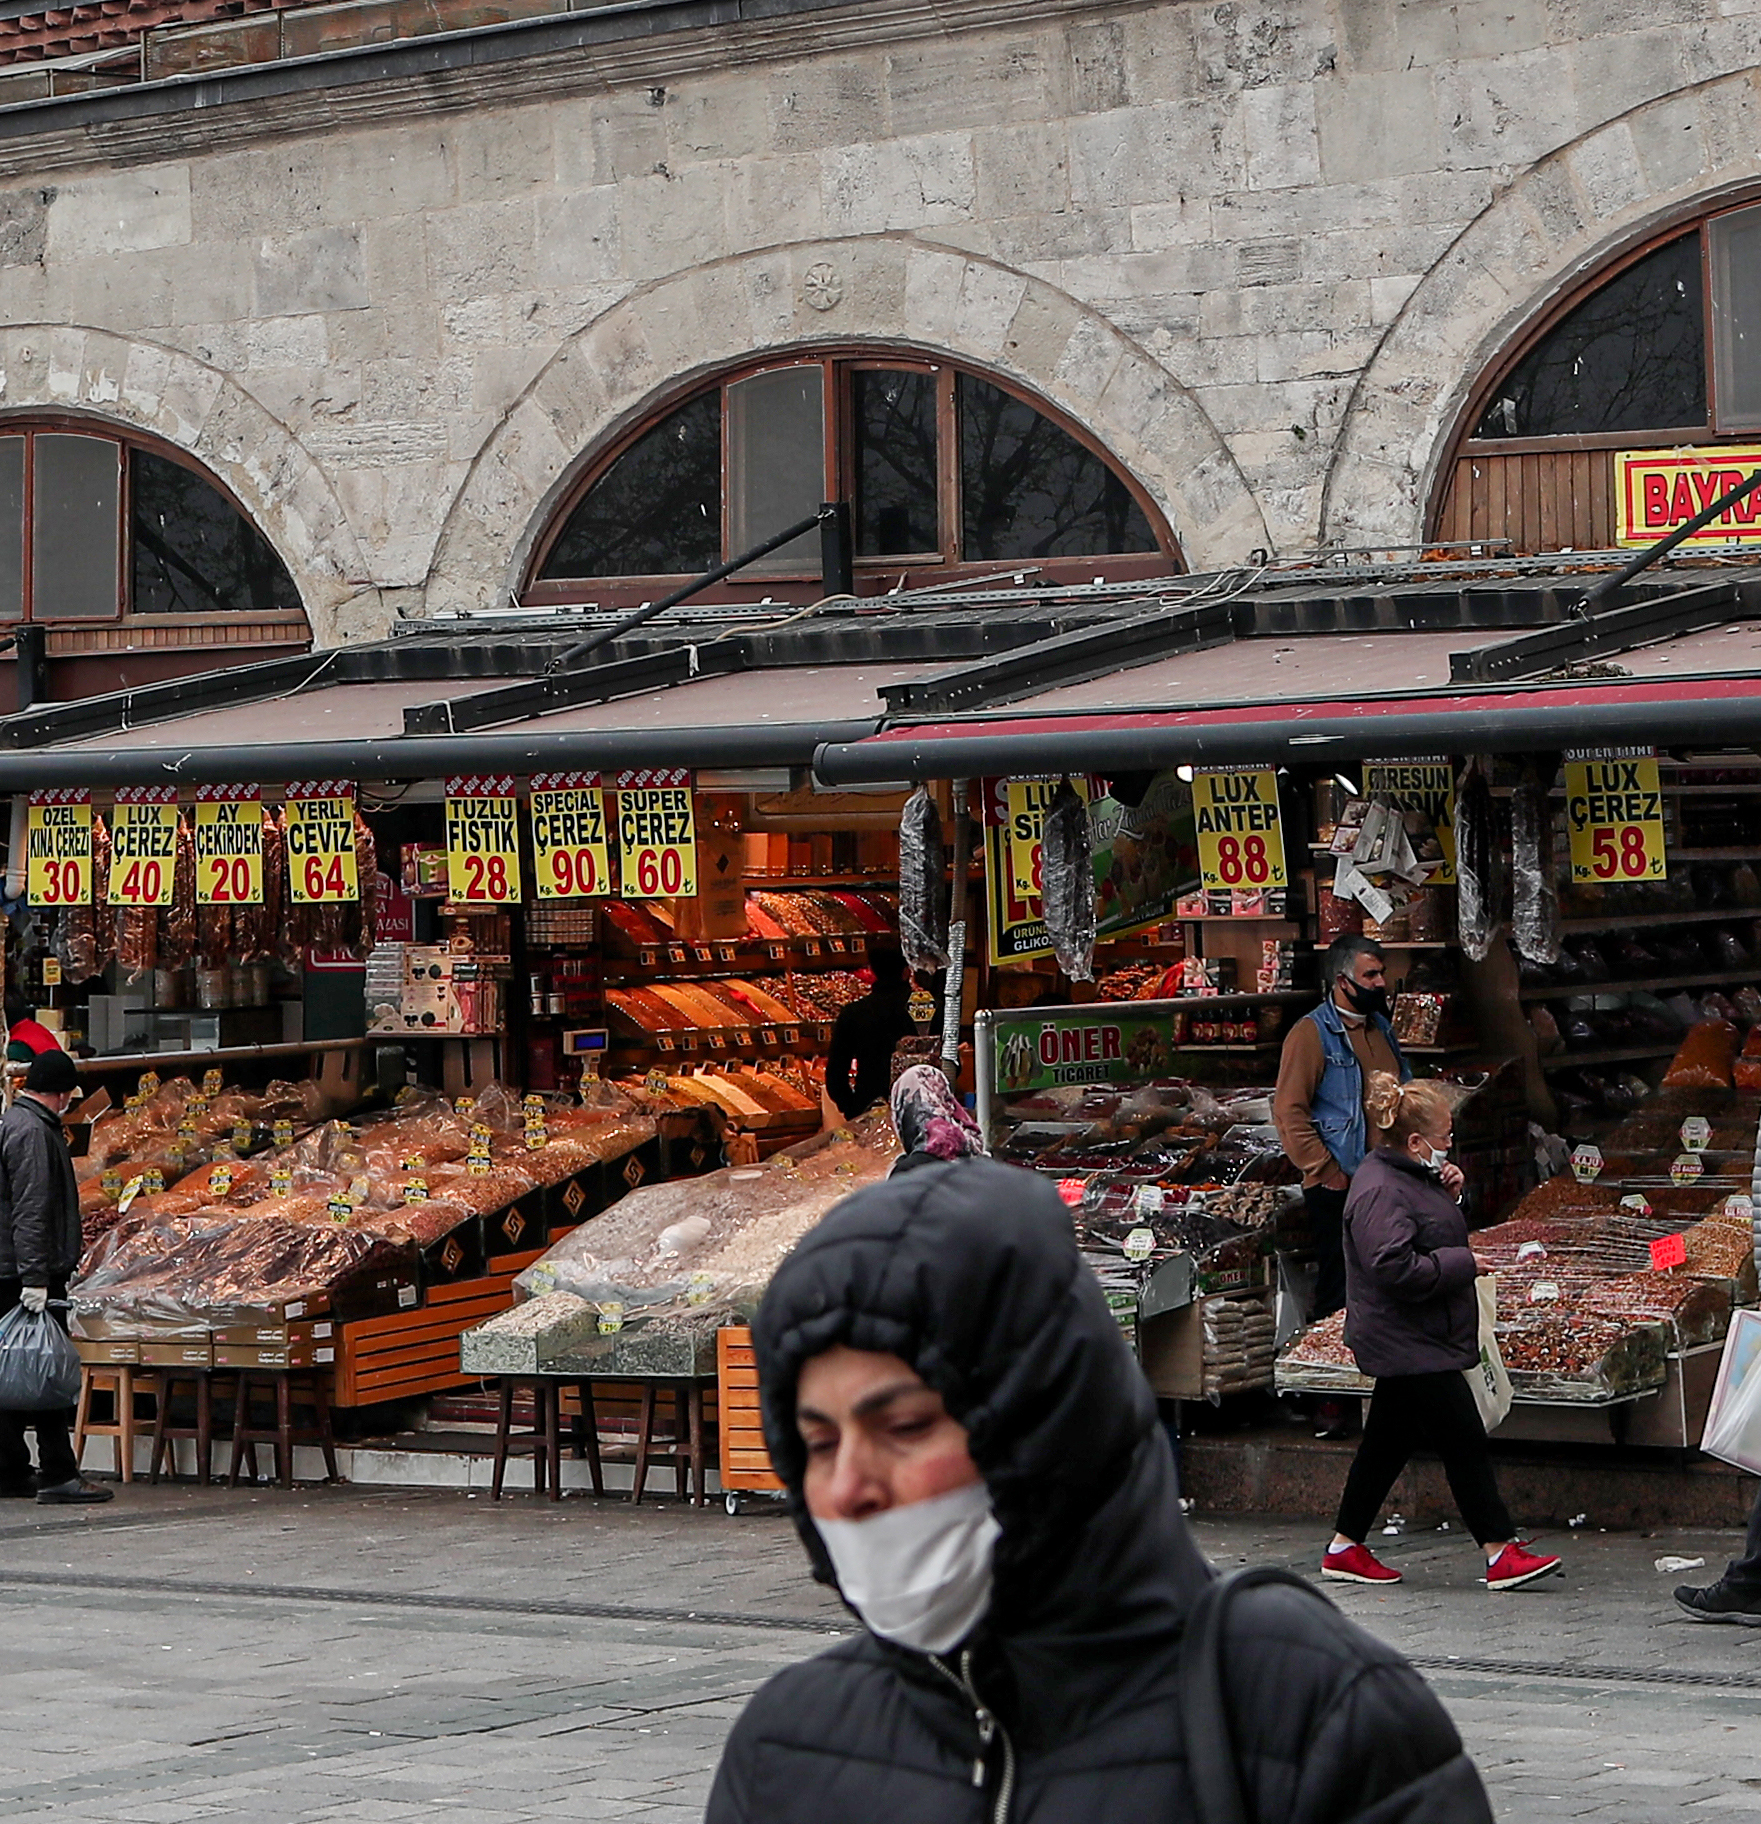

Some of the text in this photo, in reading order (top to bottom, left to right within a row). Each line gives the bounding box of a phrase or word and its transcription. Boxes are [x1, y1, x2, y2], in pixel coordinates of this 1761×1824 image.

[1209, 773, 1262, 804] LÜX
[1586, 759, 1641, 793] LÜX
[43, 805, 77, 826] ÖZEL
[217, 804, 239, 823] AY
[450, 800, 513, 819] TUZLU
[621, 788, 687, 812] SÜPER
[1197, 803, 1279, 833] ANTEP
[1570, 793, 1661, 832] ÇEREZ
[30, 828, 53, 858] KINA
[114, 827, 174, 865] ÇEREZ
[448, 821, 516, 853] FISTIK
[534, 811, 602, 856] ÇEREZ
[621, 811, 692, 855] ÇEREZ
[1592, 826, 1646, 878] 58
[211, 858, 250, 901] 20
[305, 855, 345, 899] 64
[465, 855, 507, 901] 28
[552, 848, 596, 895] 90
[638, 848, 682, 895] 60
[1217, 835, 1270, 885] 88
[43, 861, 80, 903] 30
[121, 861, 161, 903] 40
[1040, 1022, 1122, 1066] ÖNER
[1573, 1155, 1600, 1167] KAJU
